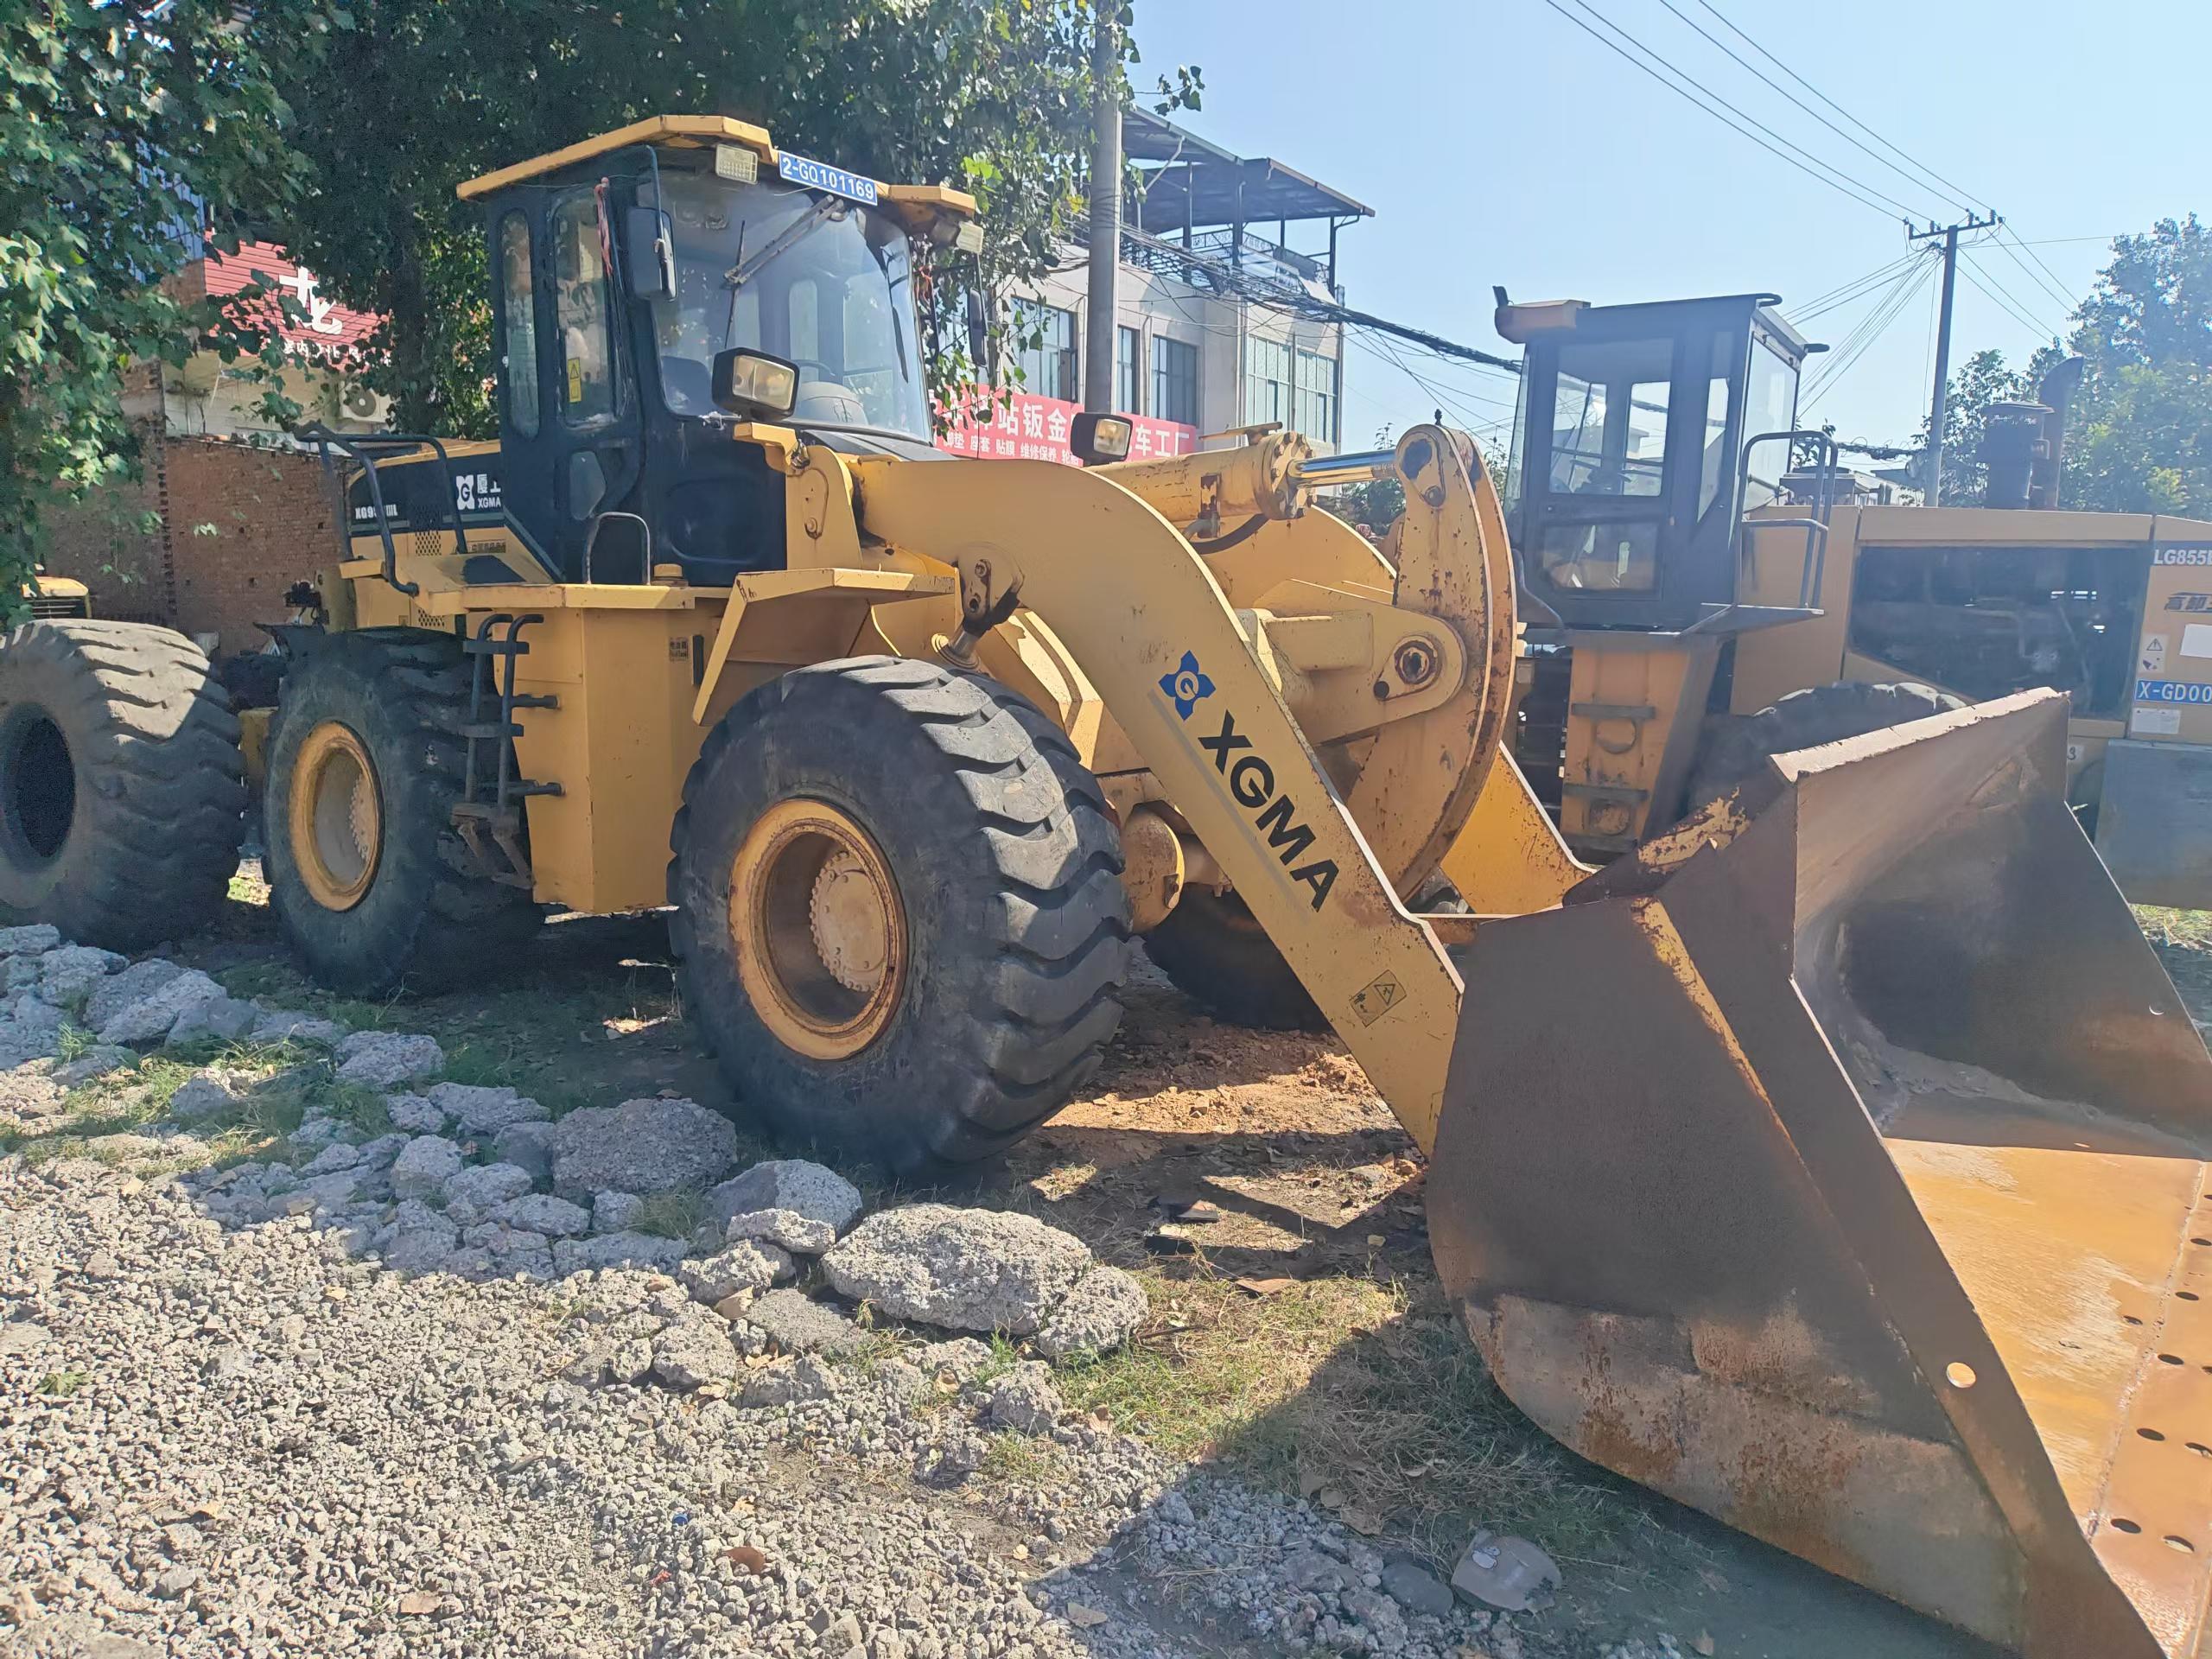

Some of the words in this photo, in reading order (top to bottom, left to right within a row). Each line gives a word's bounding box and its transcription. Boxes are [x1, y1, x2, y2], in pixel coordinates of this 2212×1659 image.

[995, 439, 1015, 457] 贴膜
[1020, 442, 1057, 463] 维修保养
[477, 496, 502, 509] XGMA
[1198, 709, 1339, 912] XGMA
